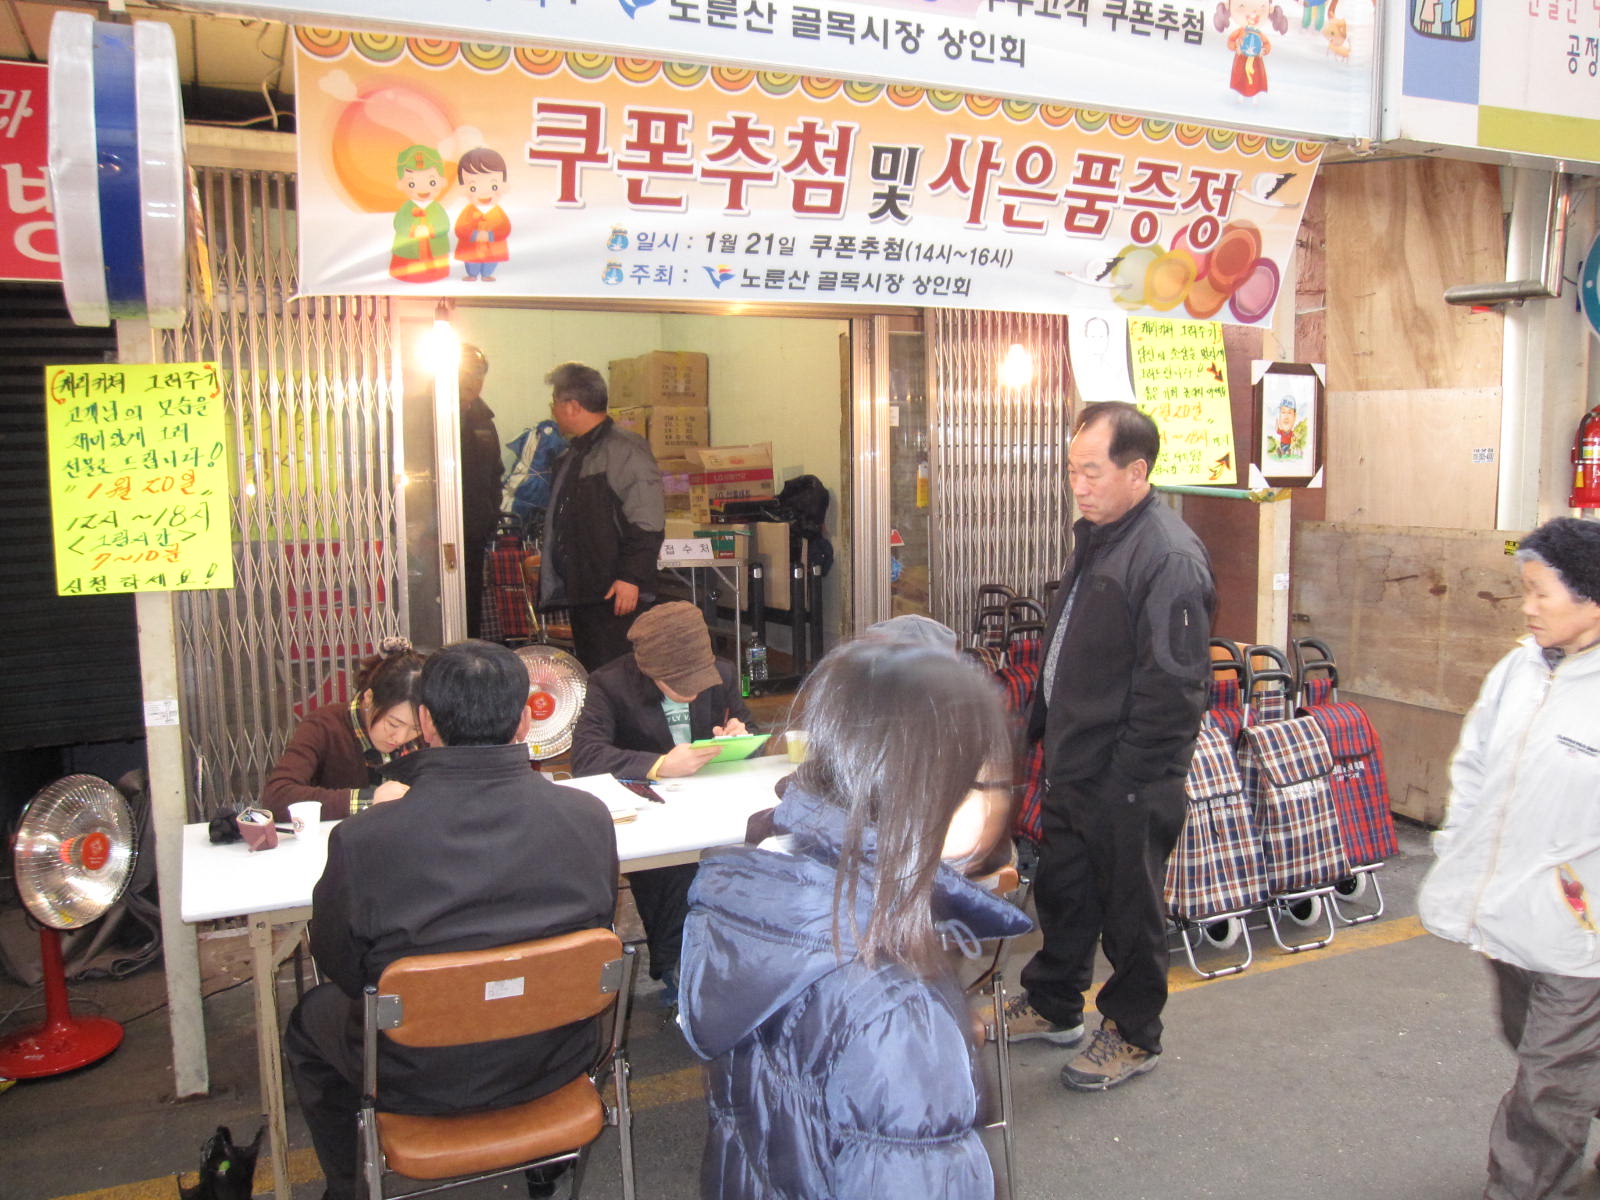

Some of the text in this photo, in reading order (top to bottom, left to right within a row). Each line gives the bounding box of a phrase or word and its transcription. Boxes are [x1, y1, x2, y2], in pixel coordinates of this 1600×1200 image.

[668, 0, 1025, 68] 노룬산 골목시장 상인회
[1102, 0, 1205, 45] 쿠폰추첨
[528, 100, 1241, 250] 쿠폰추첨 및 사은품증정
[705, 231, 738, 254] 1월
[744, 232, 796, 256] 21일
[629, 264, 674, 286] 주최
[740, 267, 810, 290] 노룬산
[817, 270, 904, 294] 골목시장
[912, 273, 972, 297] 상인회
[159, 396, 211, 418] 모습을
[63, 457, 113, 478] 선물로
